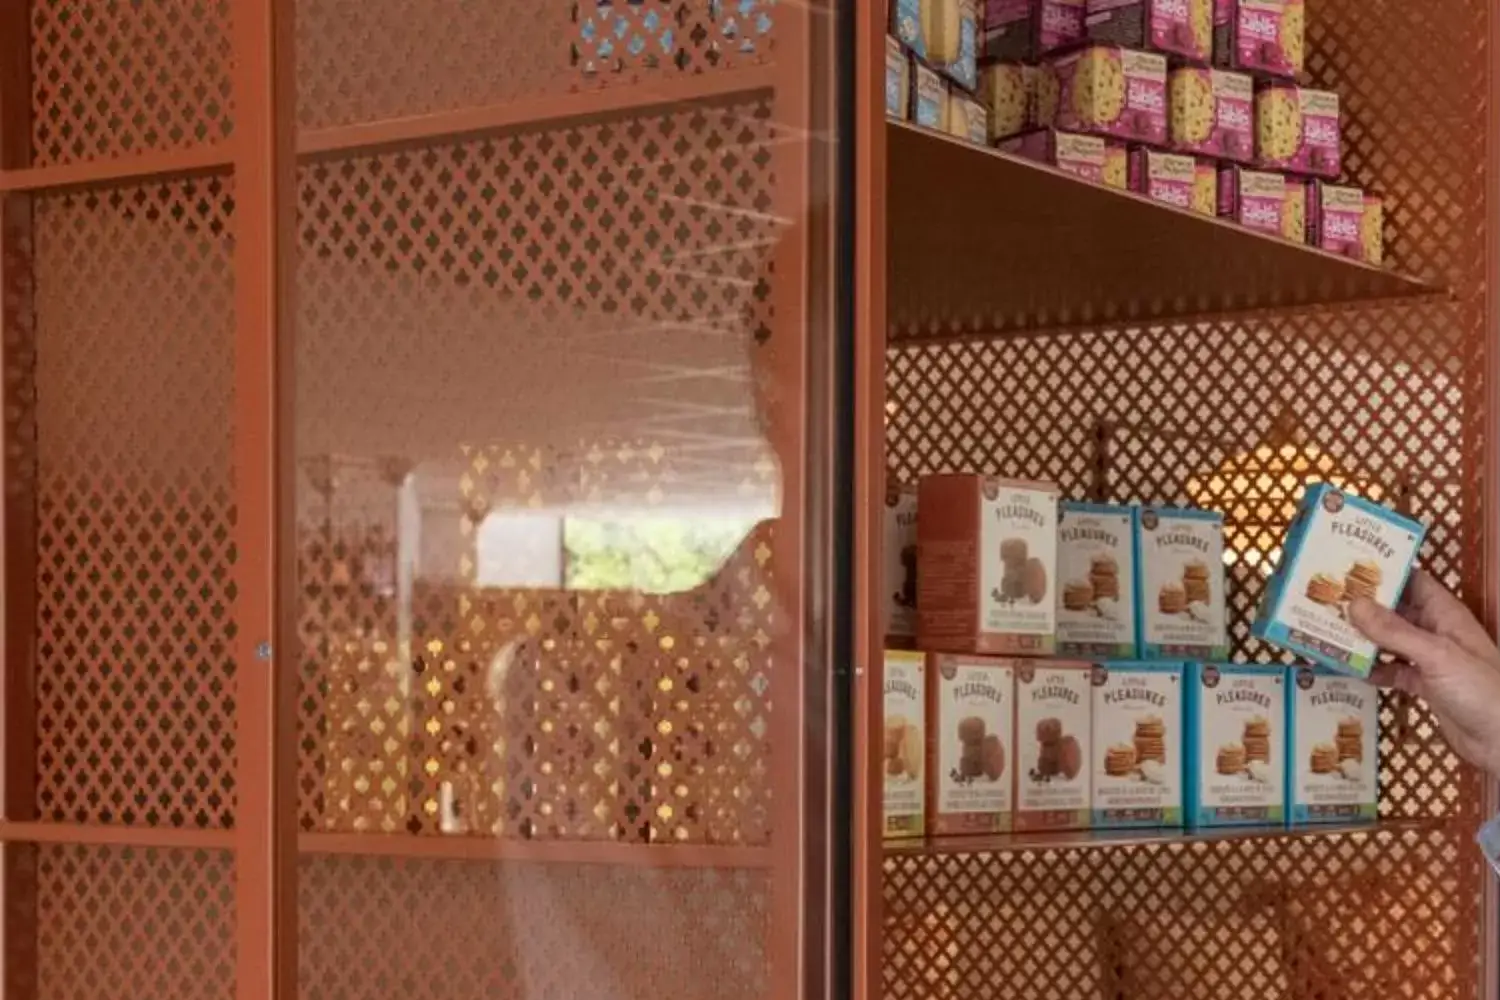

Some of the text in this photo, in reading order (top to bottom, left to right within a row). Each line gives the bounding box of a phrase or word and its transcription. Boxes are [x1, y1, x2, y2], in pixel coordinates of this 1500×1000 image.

[995, 506, 1045, 528] PLEASURES
[1059, 526, 1119, 548] PLEASURES
[1157, 533, 1211, 554] PLEASURES
[1330, 520, 1396, 560] PLEASURES
[953, 684, 1002, 704] PLEASURES
[1031, 685, 1081, 705] PLEASURES
[1104, 688, 1167, 707] PLEASURES
[1216, 691, 1272, 709] PLEASURES
[1311, 692, 1365, 710] PLEASURES
